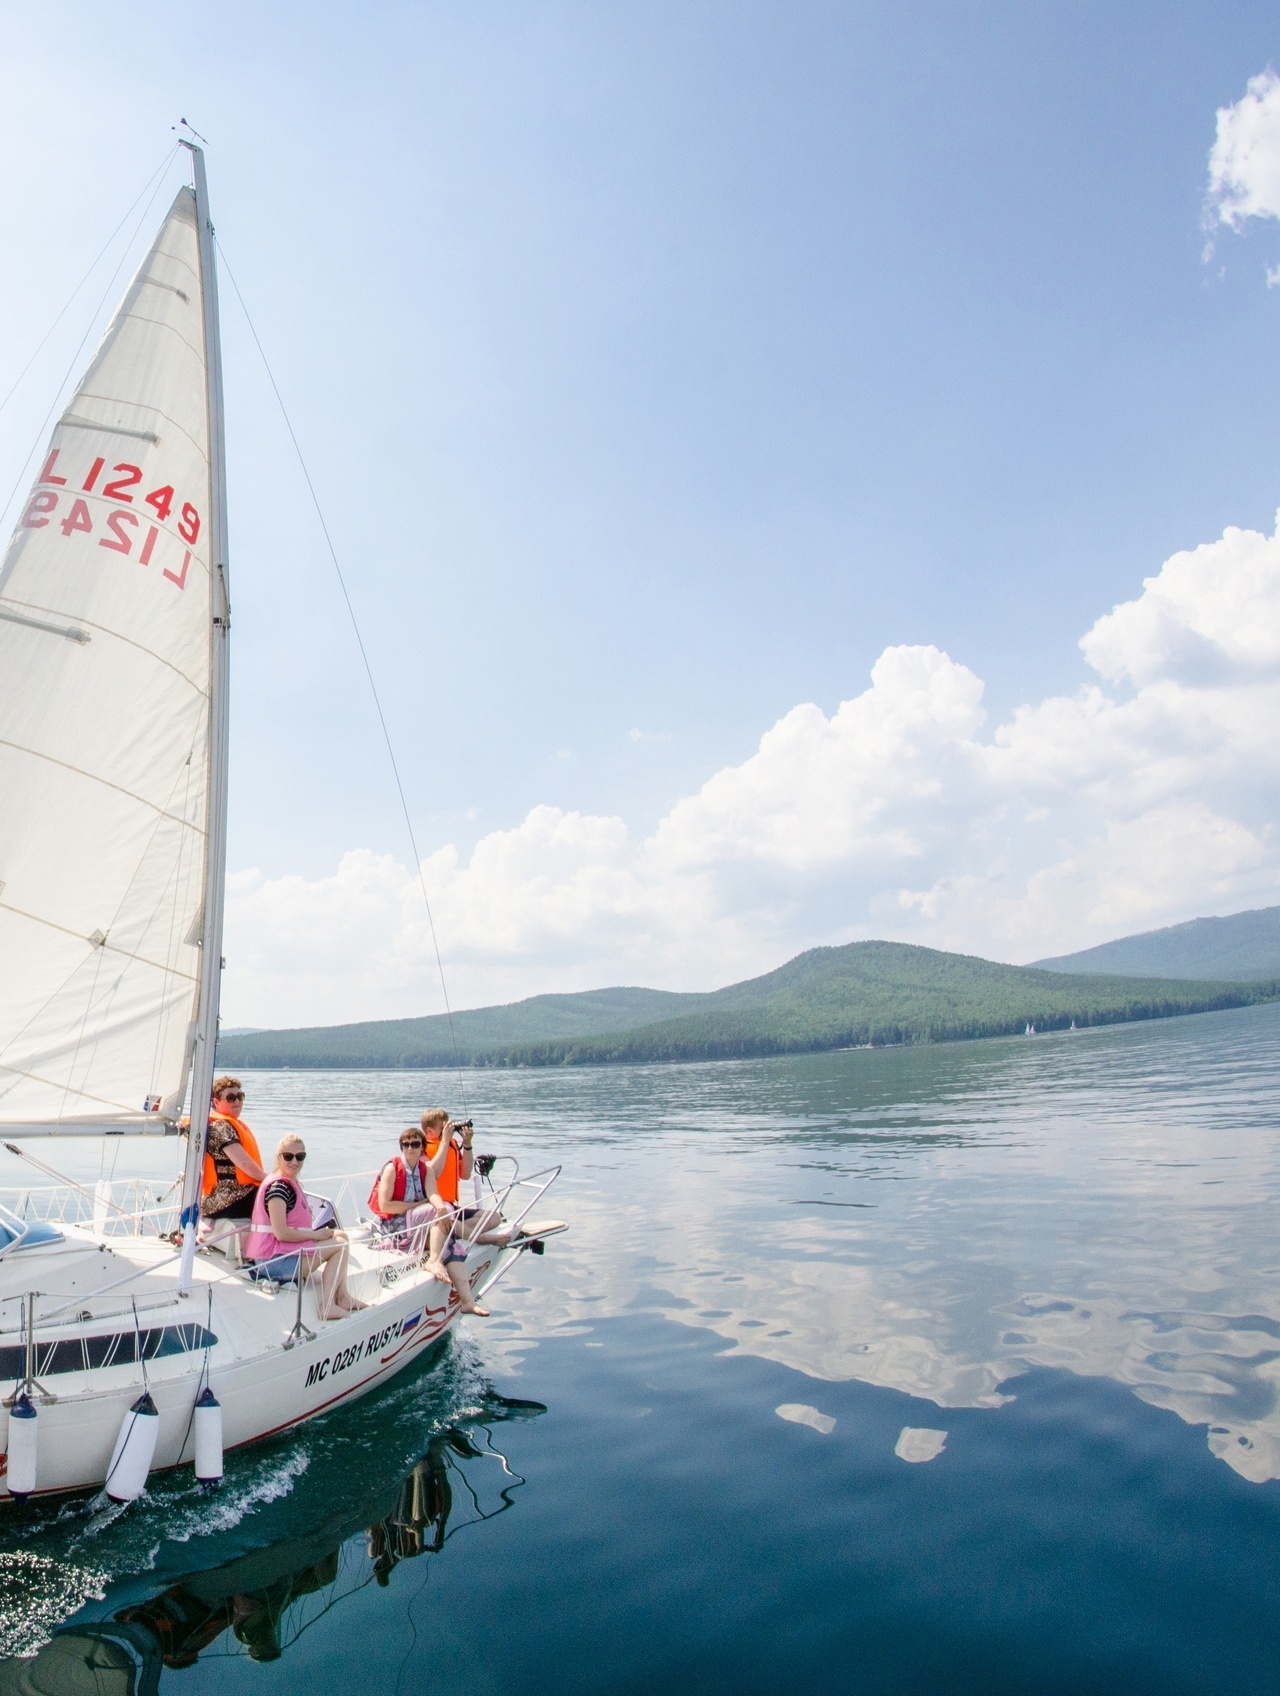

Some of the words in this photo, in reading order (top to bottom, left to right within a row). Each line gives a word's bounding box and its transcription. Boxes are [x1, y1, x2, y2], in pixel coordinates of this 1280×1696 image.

[38, 449, 201, 545] L1249
[305, 1358, 330, 1388] MC
[331, 1340, 365, 1375] 0281
